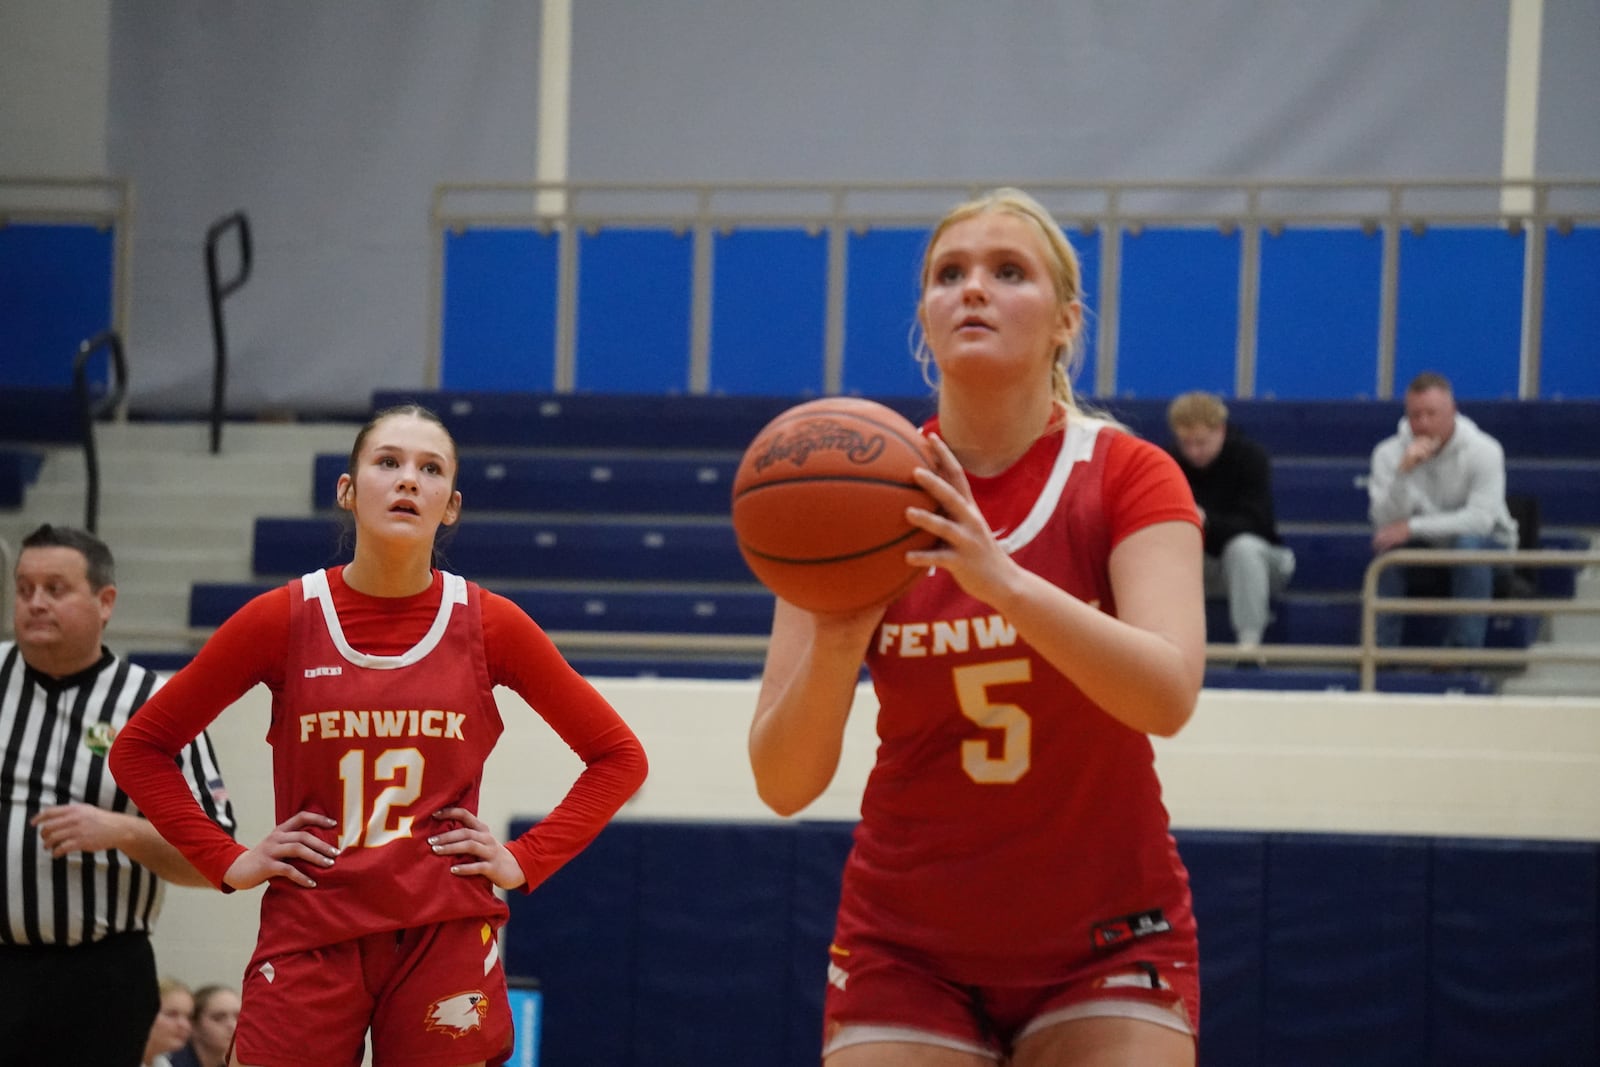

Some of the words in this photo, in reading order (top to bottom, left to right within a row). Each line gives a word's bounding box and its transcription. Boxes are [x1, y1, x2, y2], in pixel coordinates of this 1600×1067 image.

[877, 614, 1018, 658] FENW
[299, 709, 467, 743] FENWICK
[952, 657, 1033, 784] 5
[337, 747, 426, 852] 12
